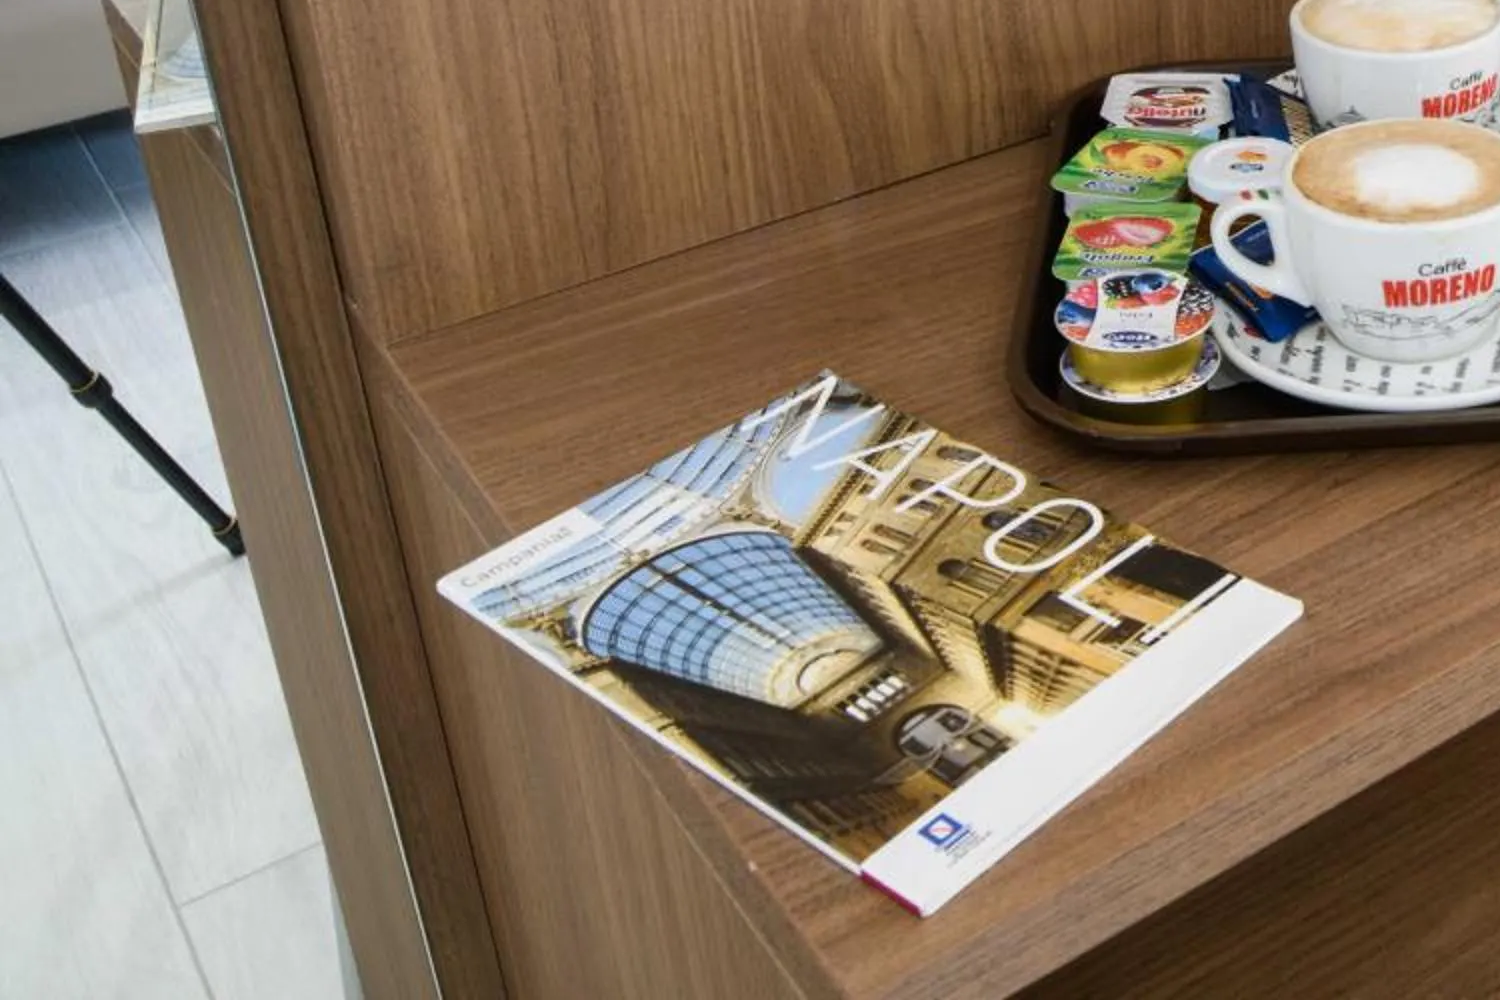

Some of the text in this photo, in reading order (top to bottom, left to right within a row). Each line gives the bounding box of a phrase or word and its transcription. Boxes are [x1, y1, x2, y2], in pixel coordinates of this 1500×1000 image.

[1421, 73, 1497, 118] MOREN
[1382, 264, 1495, 308] MORENO
[1418, 257, 1467, 277] Caffè
[741, 375, 1241, 646] NAPOLI
